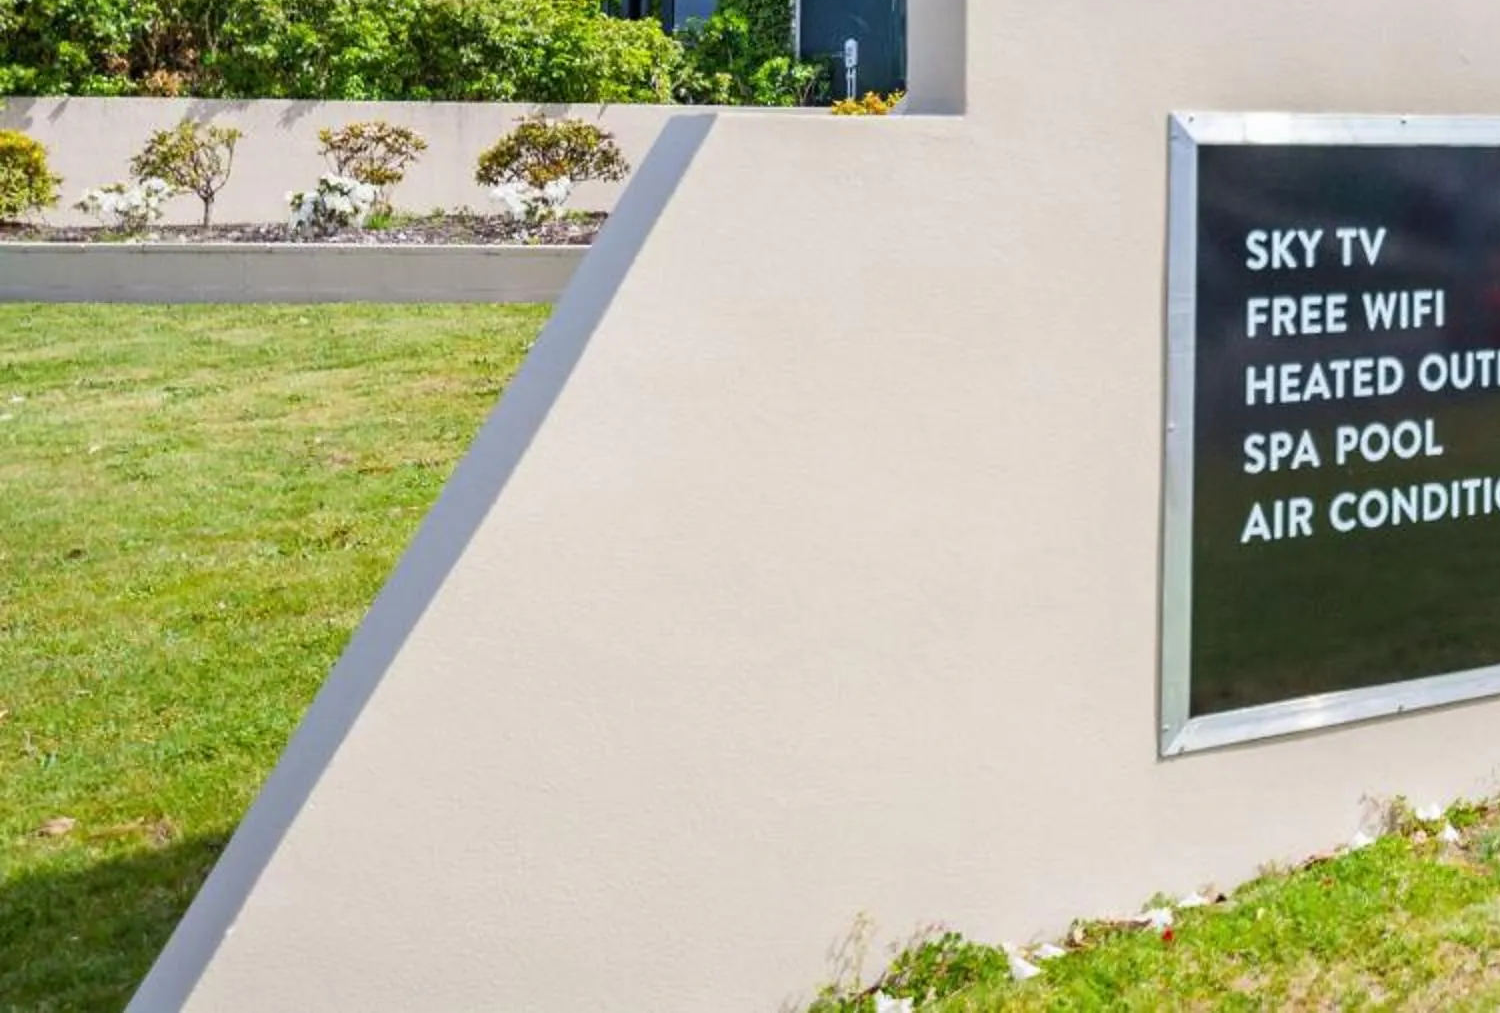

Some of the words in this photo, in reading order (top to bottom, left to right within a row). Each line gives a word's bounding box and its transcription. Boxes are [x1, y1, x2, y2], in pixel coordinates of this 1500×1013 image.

[1246, 229, 1324, 270] SKY
[1335, 227, 1387, 267] TV
[1247, 294, 1348, 338] FREE
[1362, 290, 1445, 331] WIFI
[1246, 356, 1404, 406] HEATED
[1243, 429, 1321, 474] SPA
[1336, 418, 1444, 465] POOL
[1240, 497, 1314, 544] AIR
